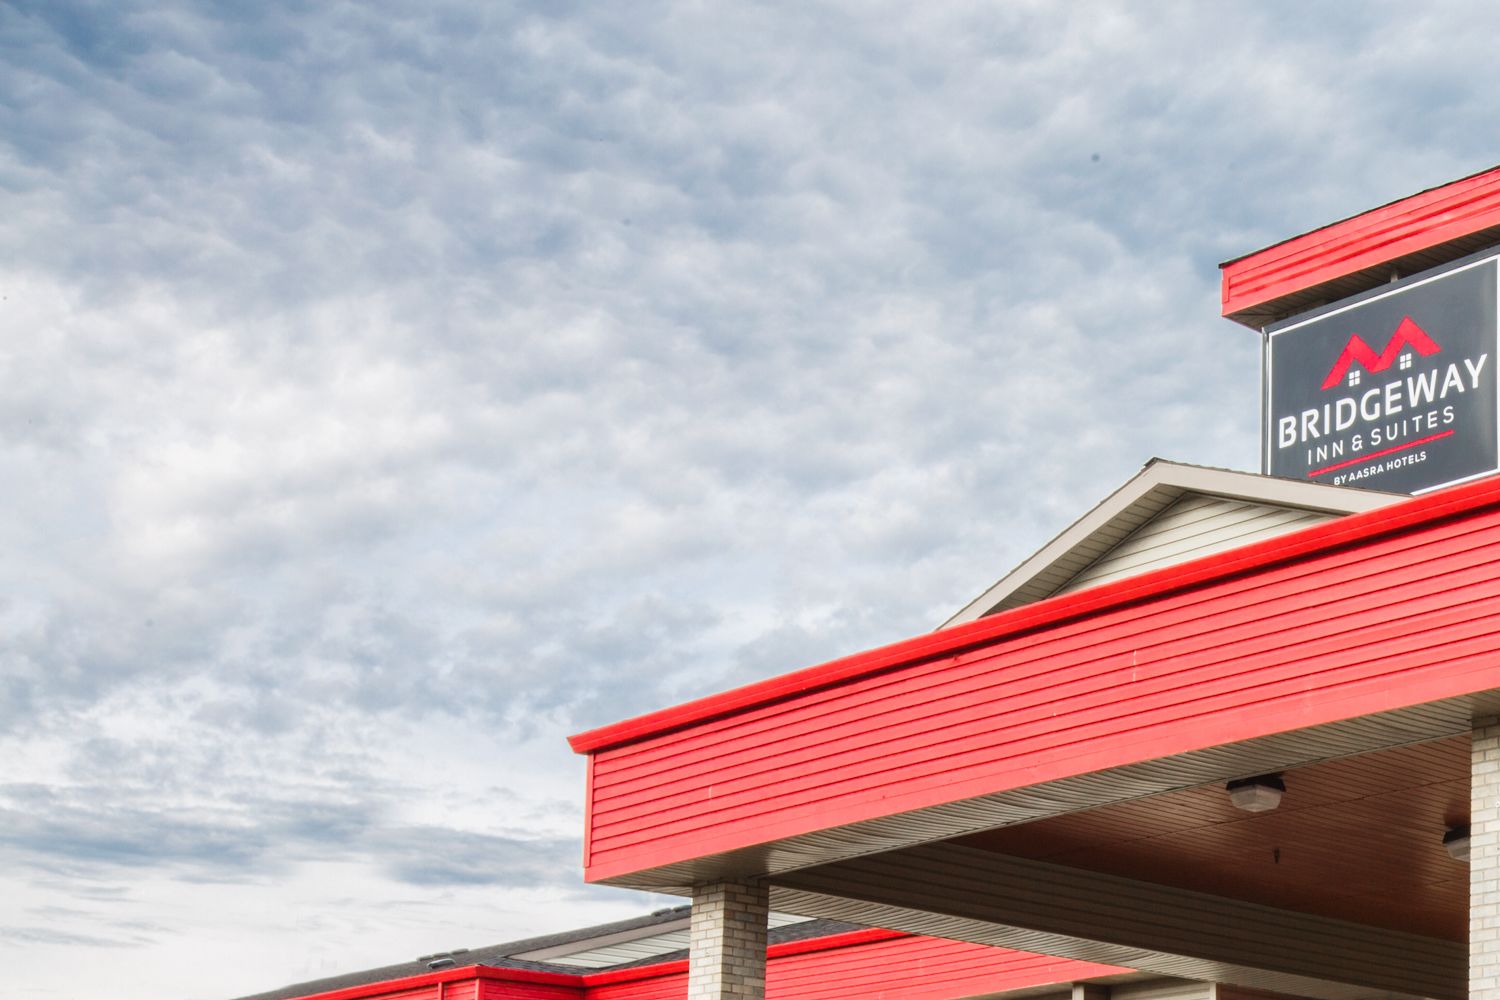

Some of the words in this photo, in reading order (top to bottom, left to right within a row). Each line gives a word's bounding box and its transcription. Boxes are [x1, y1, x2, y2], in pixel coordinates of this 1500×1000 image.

[1278, 353, 1487, 449] BRIDGEWAY
[1307, 439, 1344, 465] INN
[1351, 434, 1363, 451] &
[1370, 405, 1455, 445] SUITES
[1333, 474, 1347, 486] BY
[1348, 463, 1384, 482] AASRA
[1386, 450, 1427, 471] HOTELS
